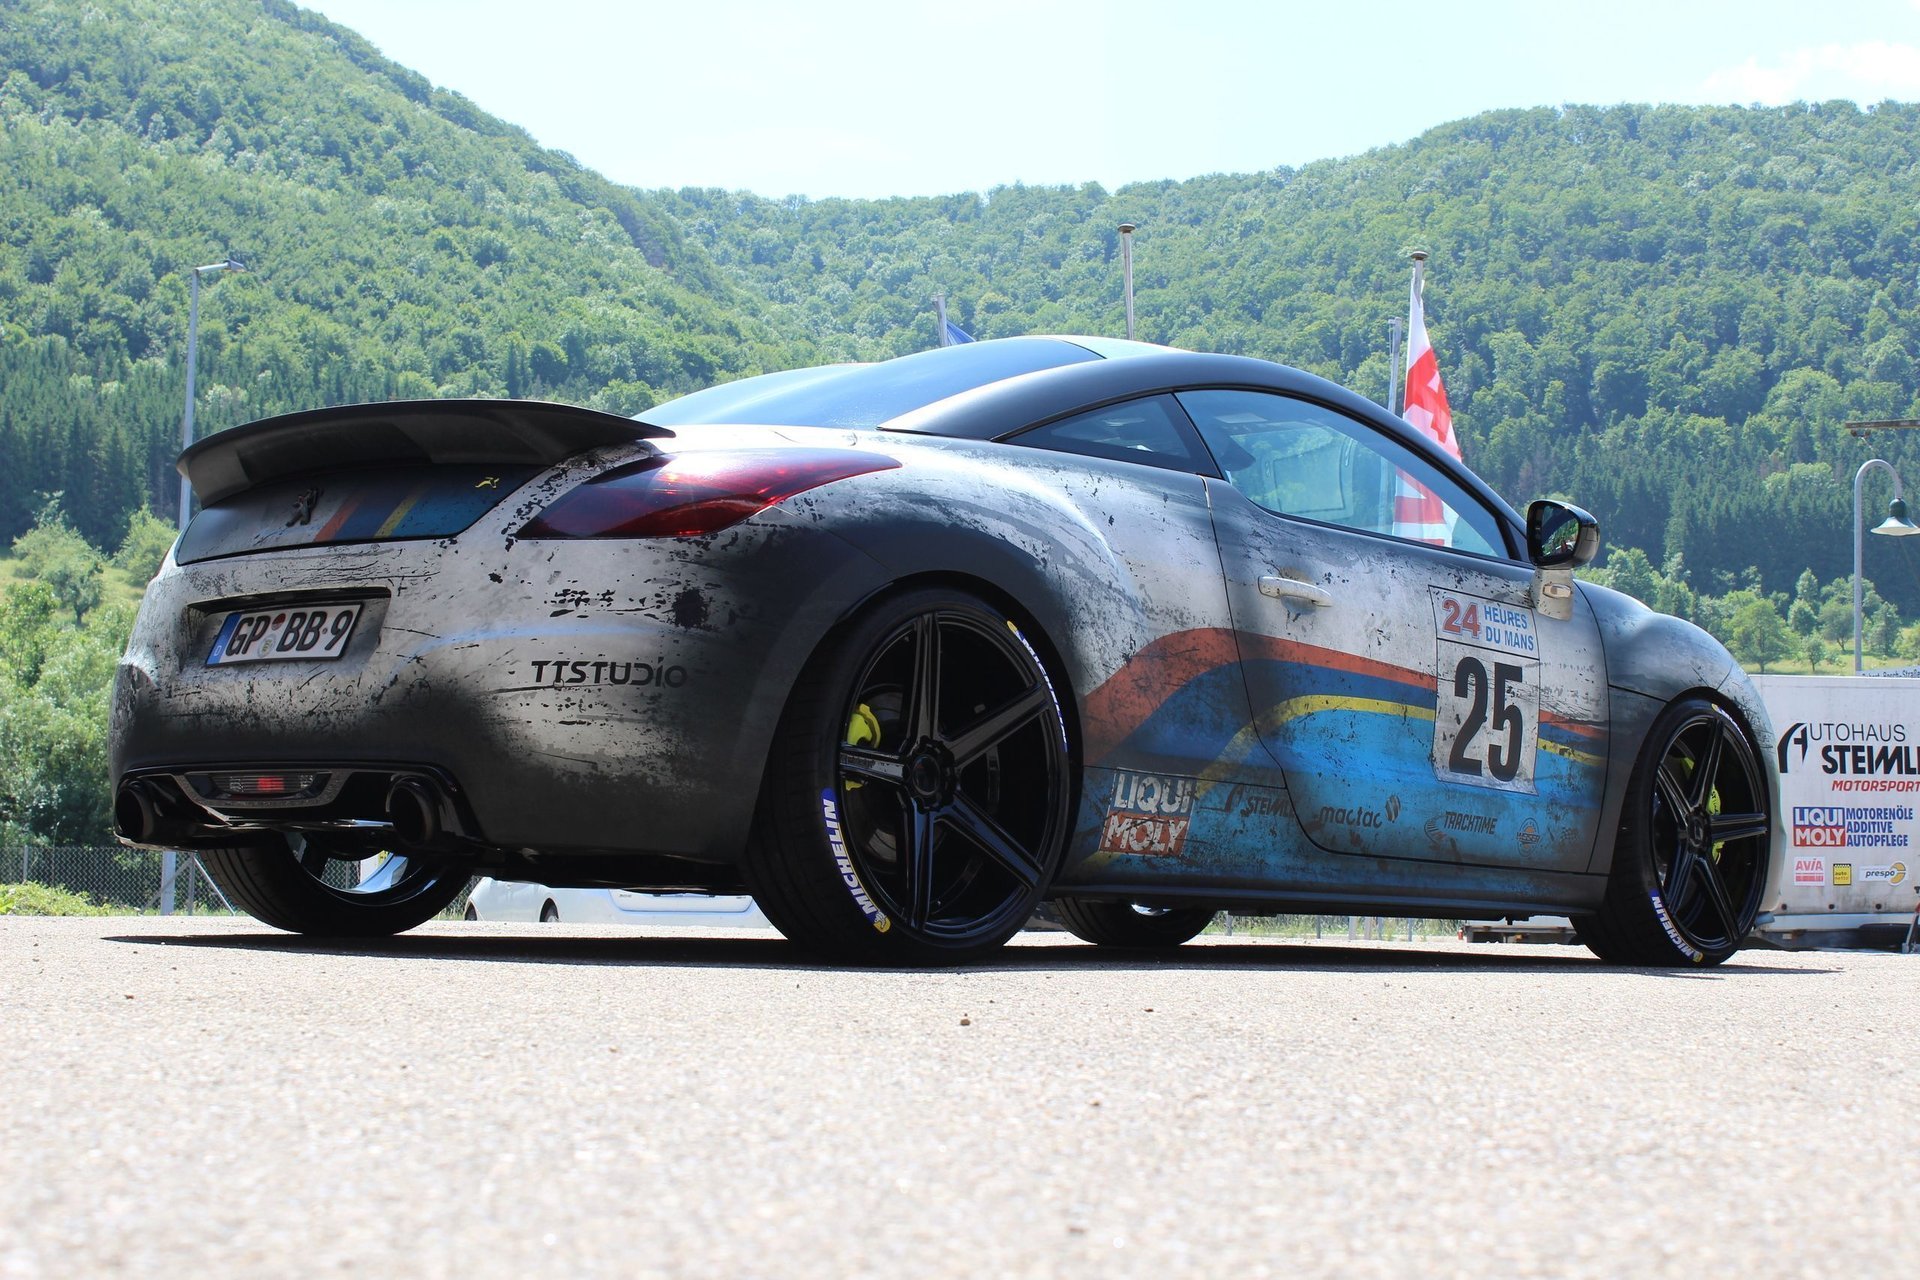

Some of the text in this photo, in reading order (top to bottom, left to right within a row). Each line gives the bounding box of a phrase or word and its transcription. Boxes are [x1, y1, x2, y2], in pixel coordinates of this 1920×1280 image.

[1442, 597, 1481, 640] 24
[1484, 605, 1528, 629] HEURES
[226, 614, 271, 656] GP
[276, 611, 328, 652] BB
[324, 610, 354, 651] 9
[1485, 626, 1534, 651] DU MANS
[1449, 656, 1523, 782] 25
[1113, 773, 1192, 814] LIQUI
[1320, 806, 1382, 828] mactac
[1794, 807, 1844, 827] LIQUI
[1846, 805, 1913, 820] MOTORENÖLE
[1104, 814, 1187, 851] MOLY
[1795, 828, 1845, 846] MOLY
[1846, 821, 1893, 834] ADDITIVE
[1846, 834, 1908, 847] AUTOPFLEGE
[823, 799, 877, 914] MICHELIN
[1865, 869, 1896, 878] prespo
[1651, 896, 1694, 957] MICHELIN
